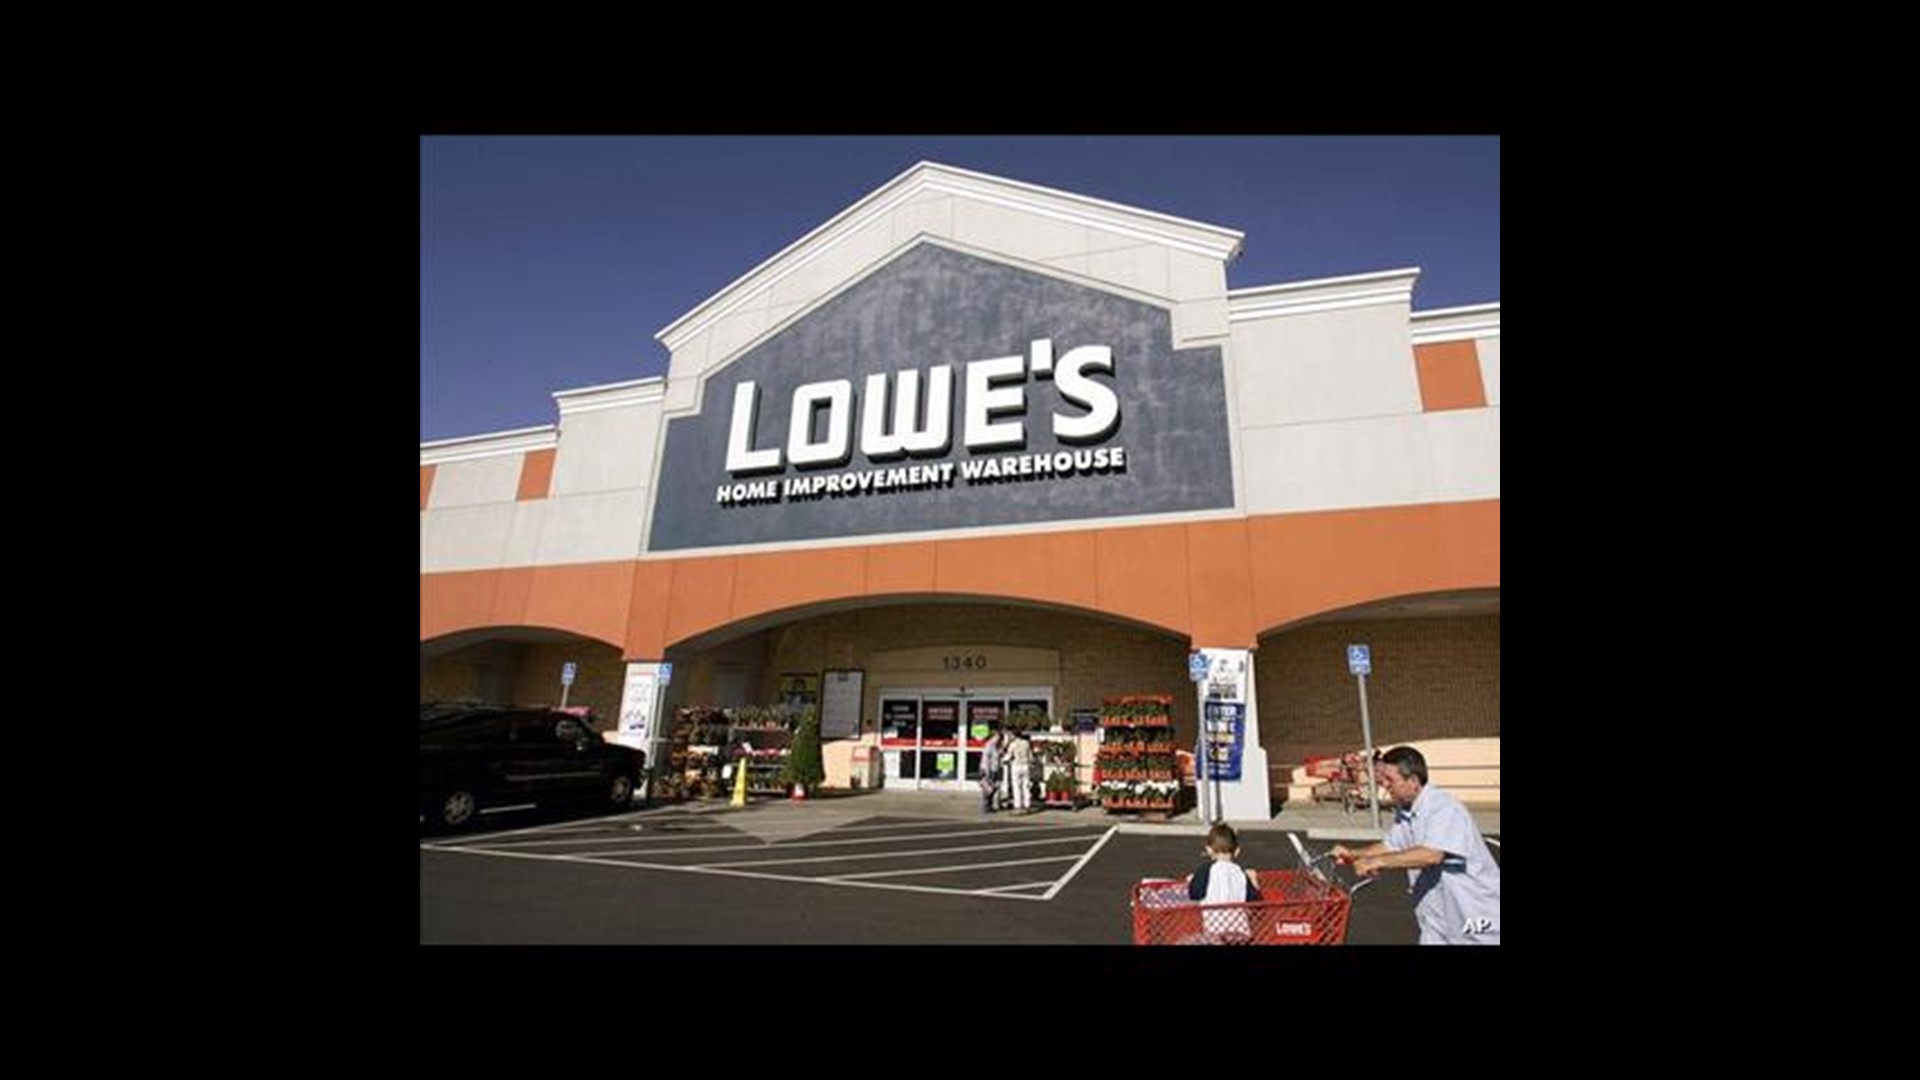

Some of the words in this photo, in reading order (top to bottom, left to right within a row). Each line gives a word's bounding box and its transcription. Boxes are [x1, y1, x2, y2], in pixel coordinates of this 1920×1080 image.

[726, 338, 1119, 472] LOWE'S
[716, 481, 776, 504] HOME
[783, 463, 953, 497] IMPROVEMENT
[961, 448, 1125, 480] WAREHOUSE
[943, 655, 987, 671] 1340
